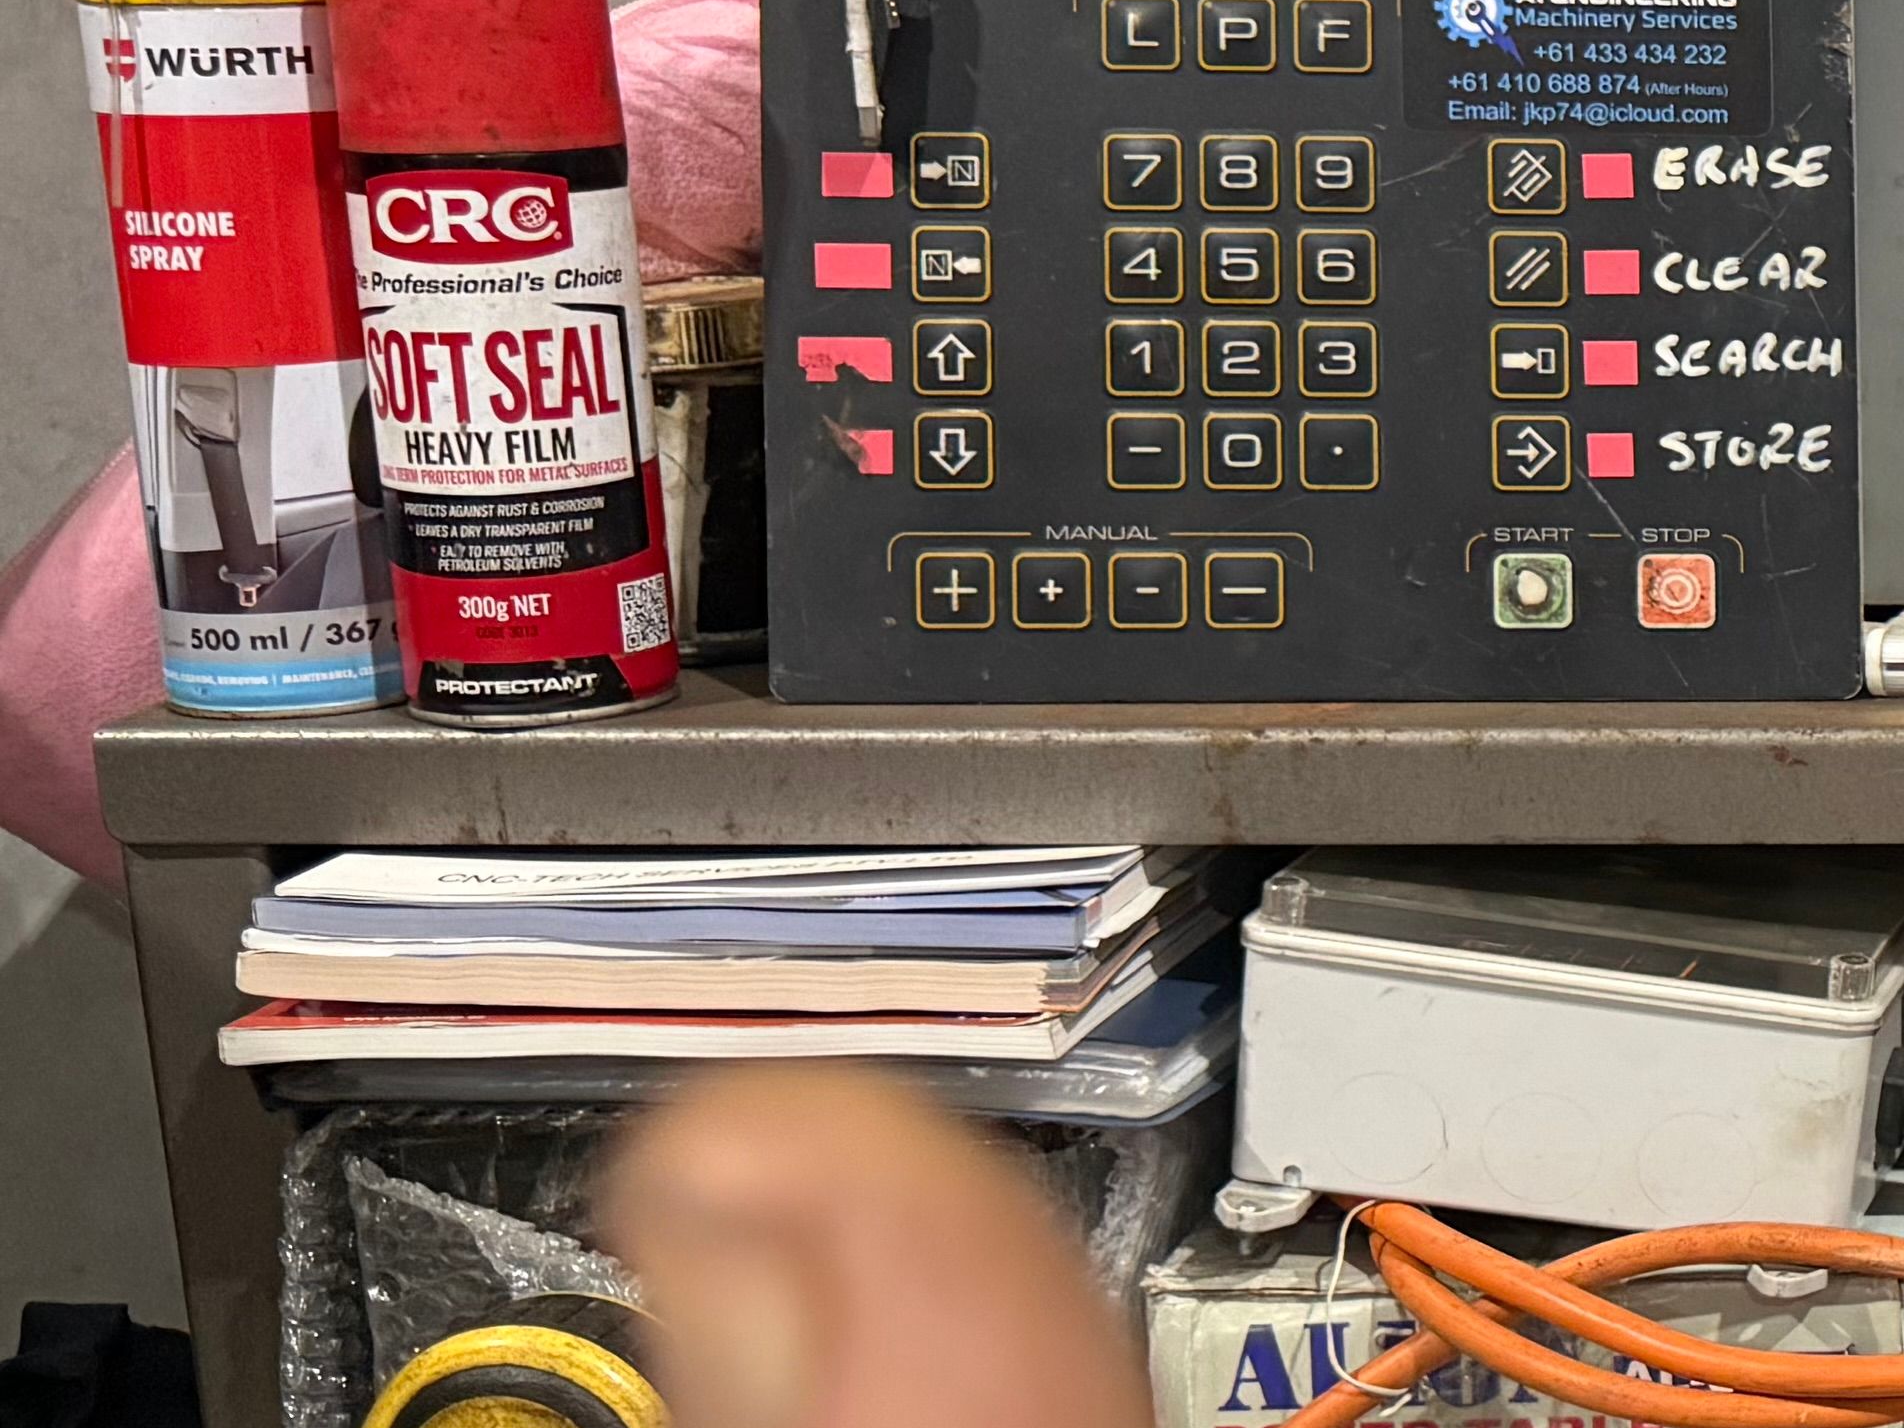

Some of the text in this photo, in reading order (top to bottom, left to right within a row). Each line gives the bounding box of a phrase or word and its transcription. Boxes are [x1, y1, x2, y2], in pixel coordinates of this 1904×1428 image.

[1516, 8, 1738, 32] Machinery Services
[1534, 44, 1727, 65] +61 433 434 232
[1448, 73, 1729, 97] +61 410 688 874 (After Hours)
[1448, 101, 1729, 126] Email: jkp74@icloud.com
[1653, 146, 1832, 190] ERASE
[125, 211, 235, 238] SILICONE
[375, 187, 559, 245] CRC
[129, 245, 204, 272] SPRAY
[1653, 246, 1827, 293] CLEAR
[371, 271, 544, 294] Professional's
[554, 265, 622, 289] Choice
[1654, 332, 1842, 378] SEARCH
[368, 324, 620, 423] SOFT SEAL
[405, 427, 576, 465] HEAVY FILM
[1659, 424, 1832, 471] STORE
[421, 467, 569, 485] PROTECTION METAL
[497, 503, 527, 517] RUST
[1045, 526, 1158, 542] MANUAL
[1494, 528, 1711, 543] START STOP
[459, 594, 550, 621] 300g NET
[191, 618, 380, 652] 500 ml 367
[436, 672, 597, 695] PROTECTANT
